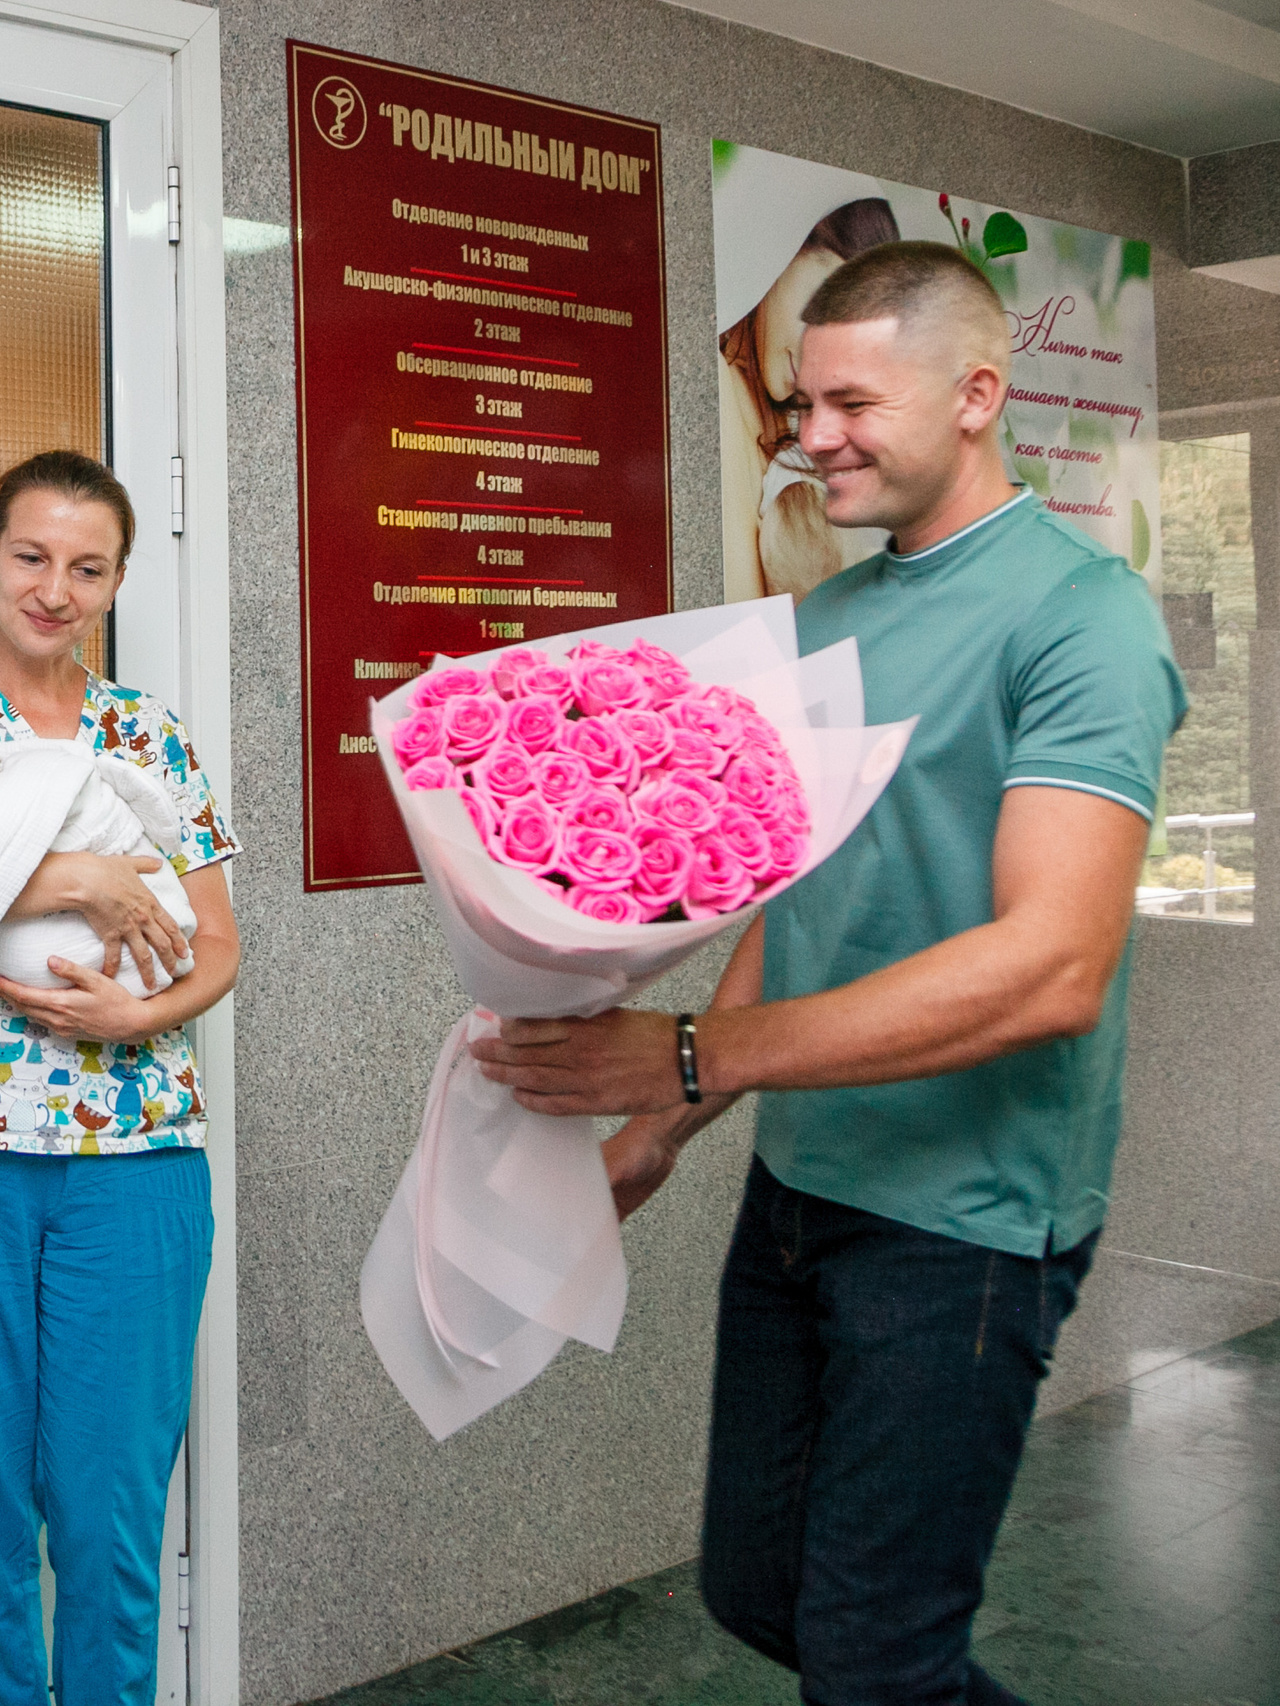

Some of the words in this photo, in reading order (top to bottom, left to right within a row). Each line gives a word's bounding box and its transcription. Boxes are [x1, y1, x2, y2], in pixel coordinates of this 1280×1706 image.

[393, 198, 473, 231] Отделение
[476, 214, 589, 251] новорожденных
[461, 245, 468, 262] 1
[470, 249, 479, 263] и
[483, 248, 491, 266] 3
[494, 253, 529, 272] этаж
[344, 265, 559, 317] Акушерско-физиологическое
[563, 303, 633, 328] отделение
[475, 318, 483, 337] 2
[486, 323, 520, 343] этаж
[1006, 296, 1087, 357] Ничто
[1091, 349, 1123, 363] так
[397, 351, 518, 385] Обсервационное
[520, 370, 593, 394] отделение
[476, 395, 484, 414] 3
[487, 399, 523, 418] этаж
[392, 428, 525, 460] Гинекологическое
[528, 446, 599, 466] отделение
[1015, 443, 1045, 457] как
[1049, 446, 1103, 464] счастье
[476, 471, 485, 490] 4
[488, 476, 522, 493] этаж
[378, 505, 458, 531] Стационар
[460, 512, 526, 533] дневного
[529, 516, 611, 538] пребывания
[478, 546, 486, 564] 4
[489, 548, 523, 566] этаж
[374, 582, 455, 605] Отделение
[458, 587, 531, 606] патологии
[533, 588, 618, 608] беременных
[480, 619, 486, 638] 1
[489, 622, 524, 638] этаж
